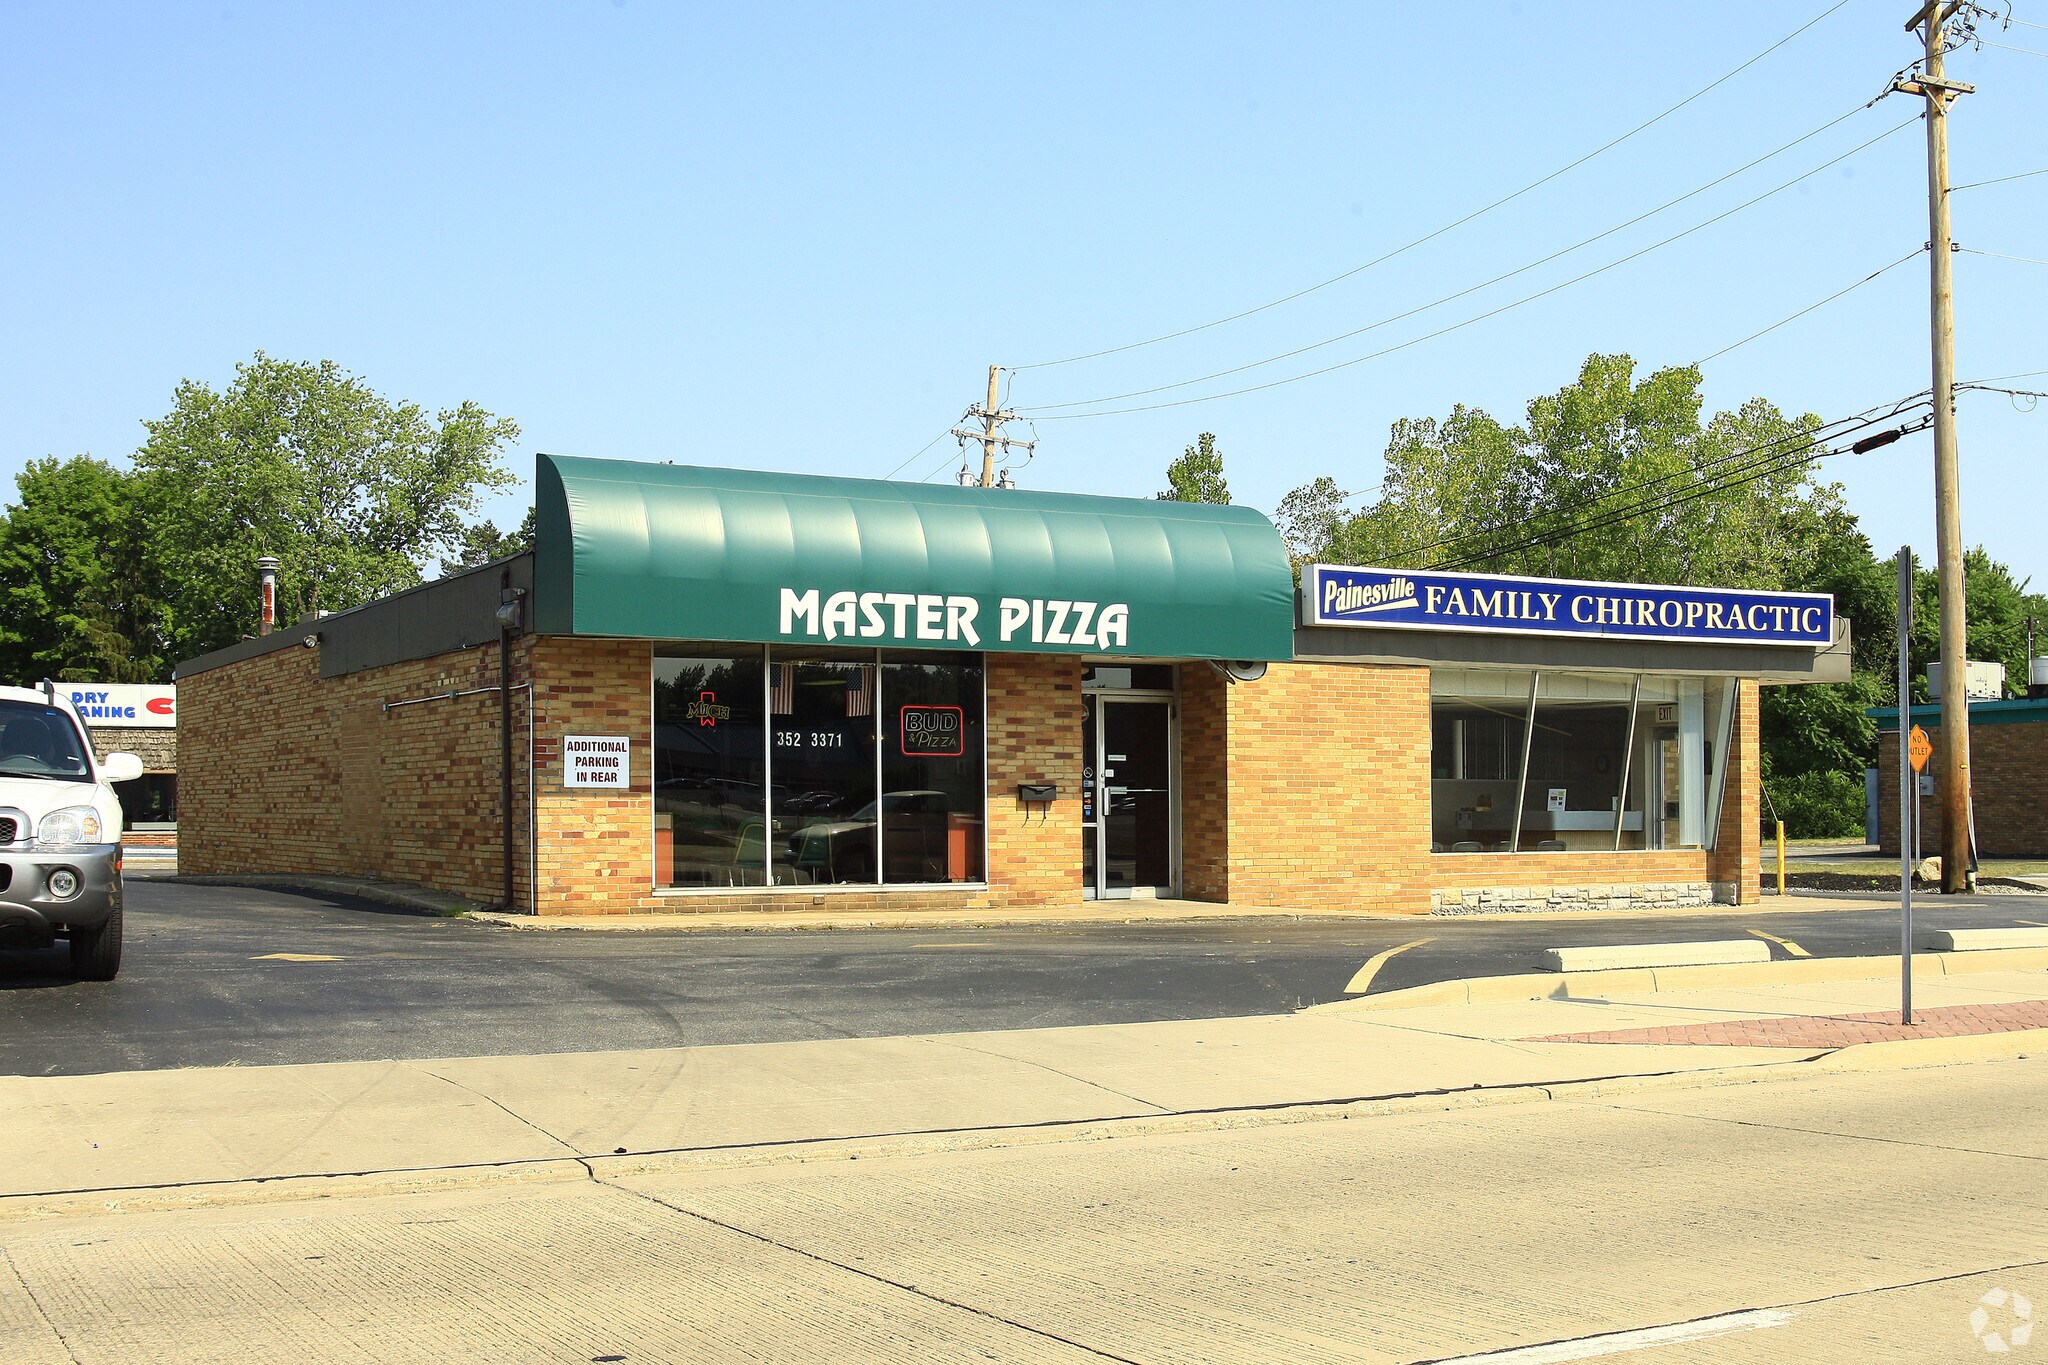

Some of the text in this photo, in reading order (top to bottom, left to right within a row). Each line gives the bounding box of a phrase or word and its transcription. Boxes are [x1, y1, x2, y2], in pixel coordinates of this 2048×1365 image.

[1323, 577, 1823, 634] Painesville FAMILY CHIROPRACTIC
[779, 587, 1130, 651] MASTER PIZZA
[72, 692, 109, 704] DRY
[685, 700, 731, 720] MICH
[1659, 707, 1672, 721] EXIT
[905, 712, 958, 732] BUD
[776, 731, 842, 747] 352 3371
[1912, 735, 1921, 744] NO
[567, 741, 627, 752] ADDITIONAL
[1909, 747, 1928, 756] UTLET
[575, 756, 619, 767] PARKING
[577, 772, 617, 782] IN REAR
